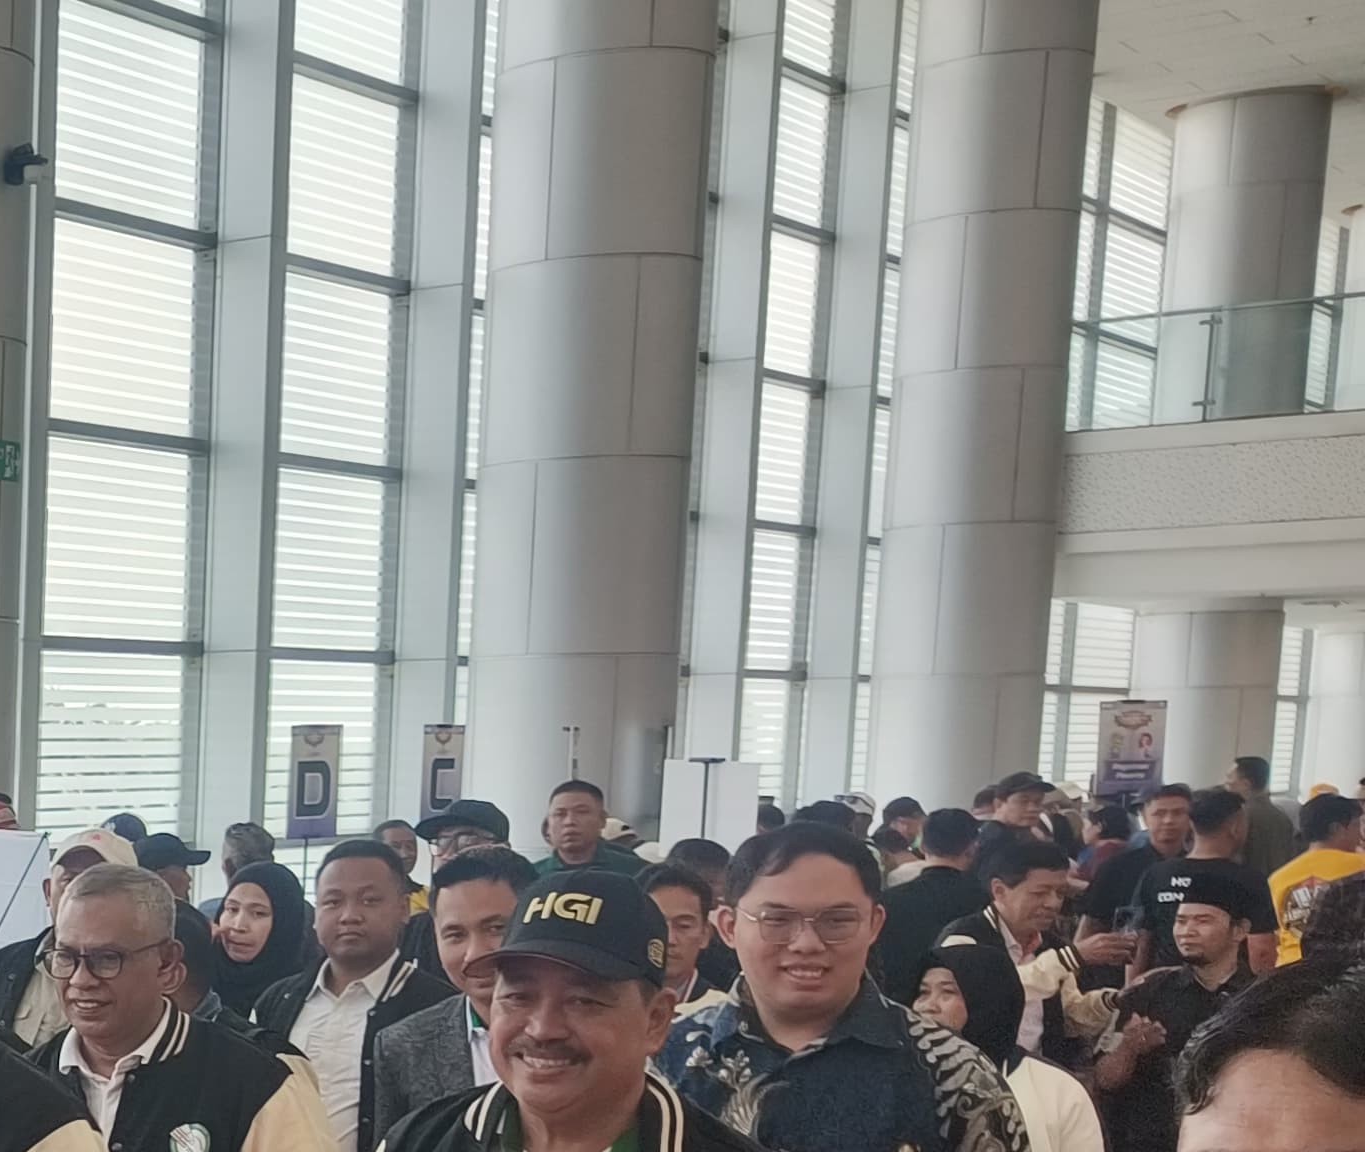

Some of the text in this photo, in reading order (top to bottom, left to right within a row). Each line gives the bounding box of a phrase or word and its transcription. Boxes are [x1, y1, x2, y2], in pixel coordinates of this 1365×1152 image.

[296, 760, 332, 818] D
[429, 757, 456, 811] C
[522, 891, 604, 925] HGI
